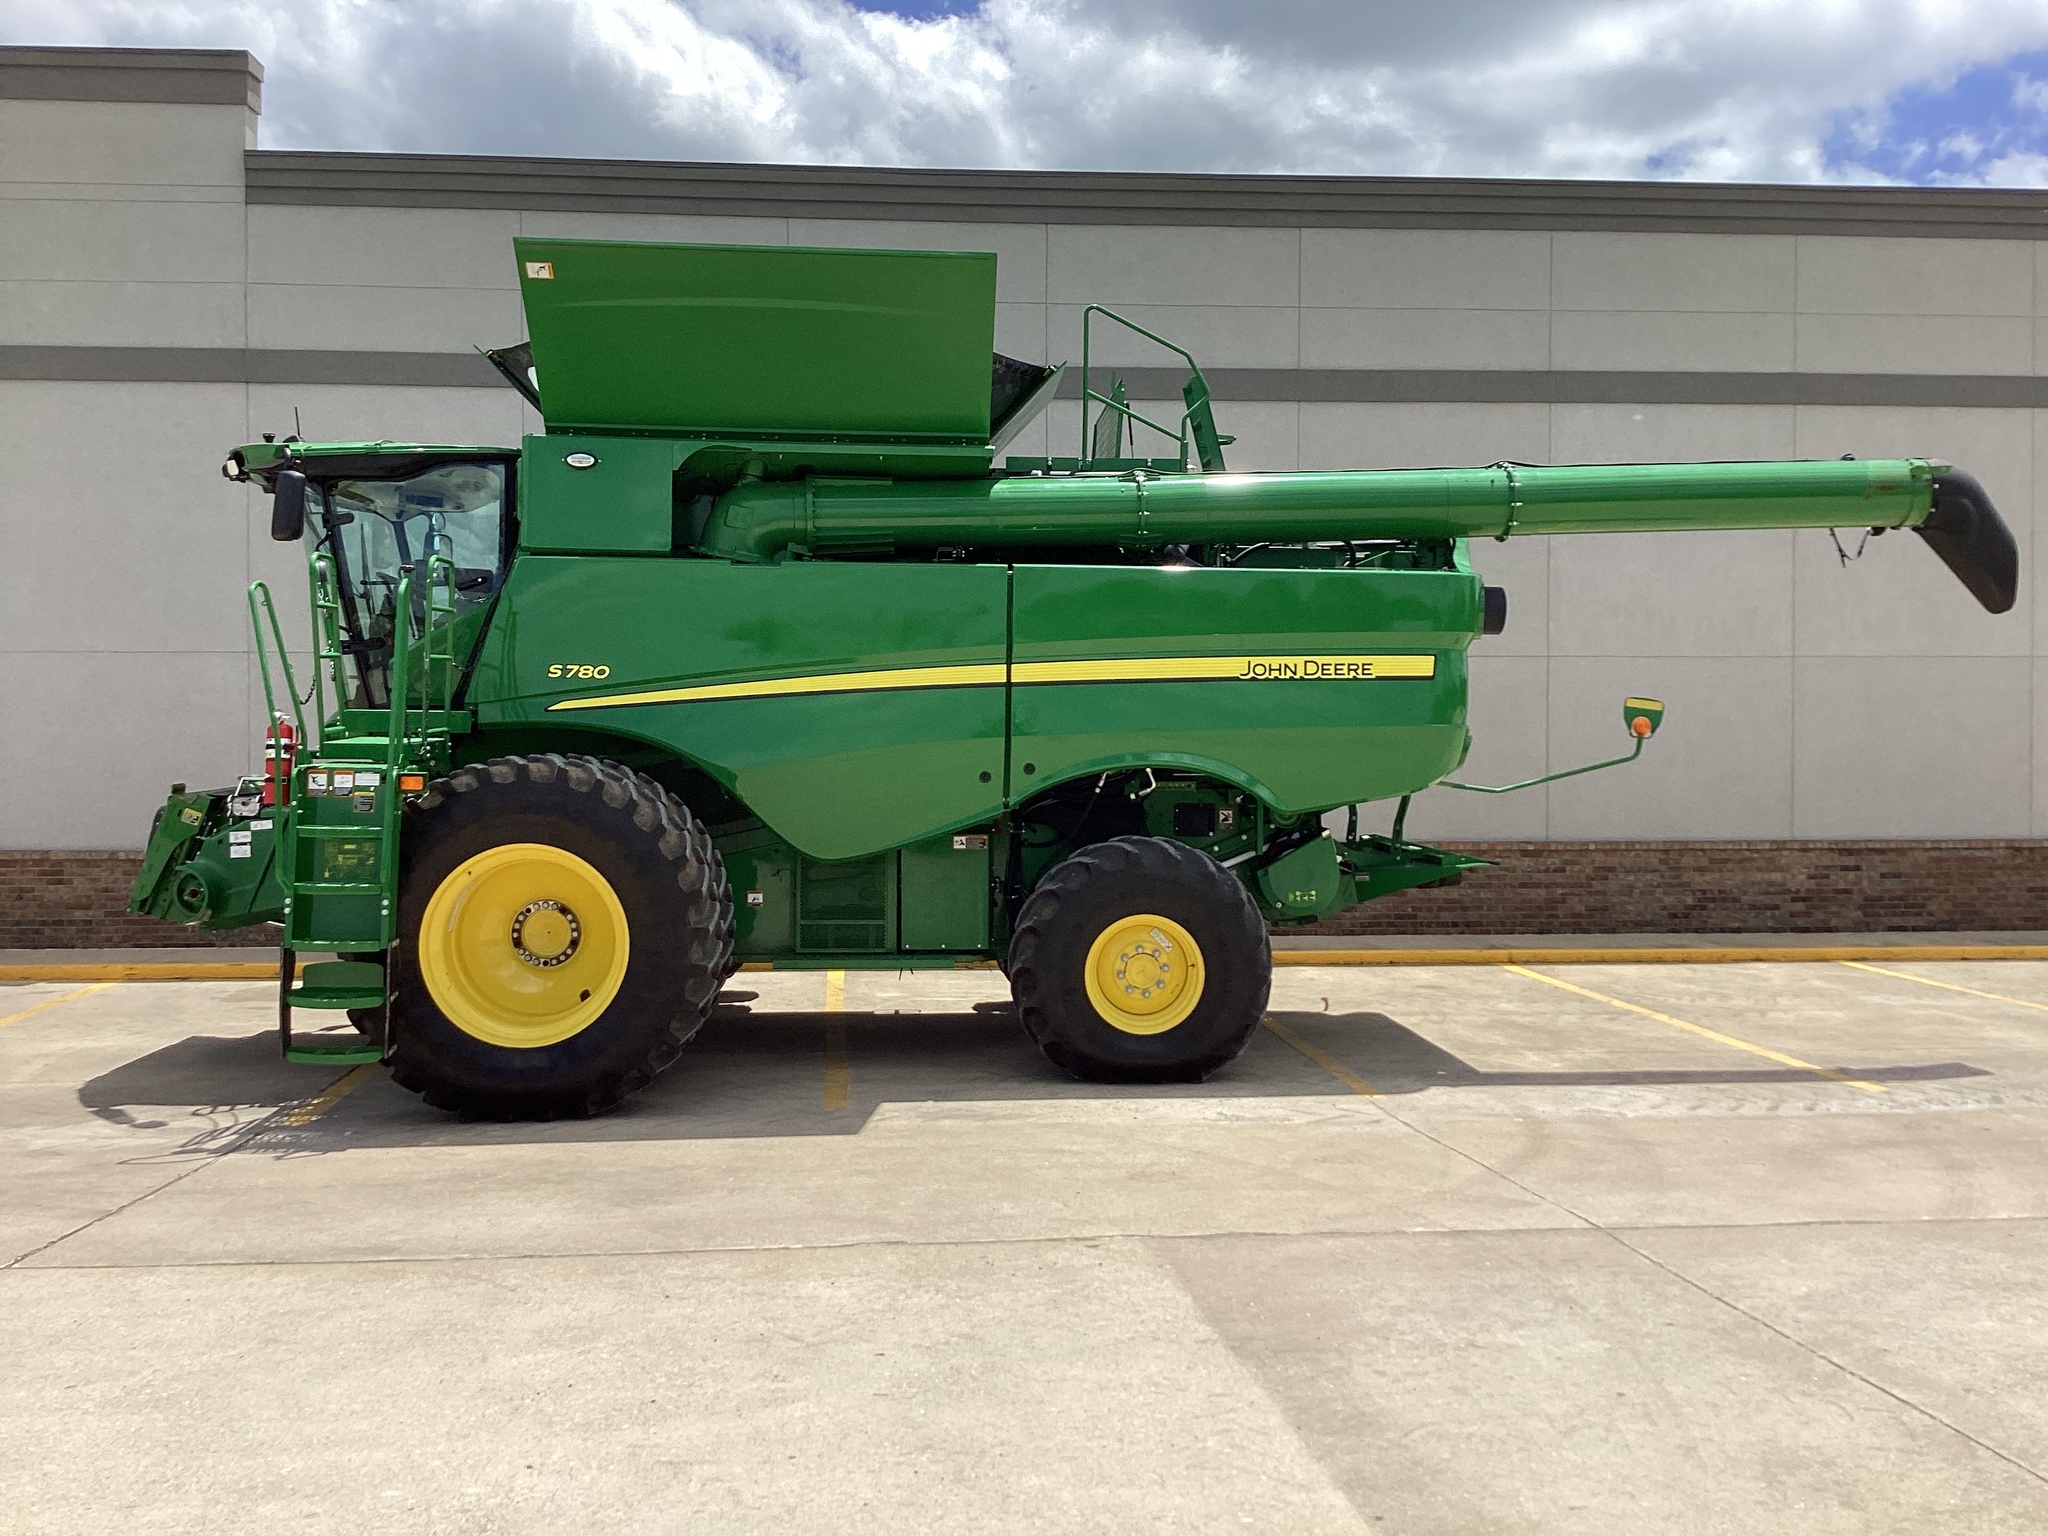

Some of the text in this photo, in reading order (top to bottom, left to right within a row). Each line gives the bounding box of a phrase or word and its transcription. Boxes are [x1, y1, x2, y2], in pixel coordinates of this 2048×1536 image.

[547, 664, 611, 679] S780
[1239, 660, 1374, 677] JOHN DEERE
